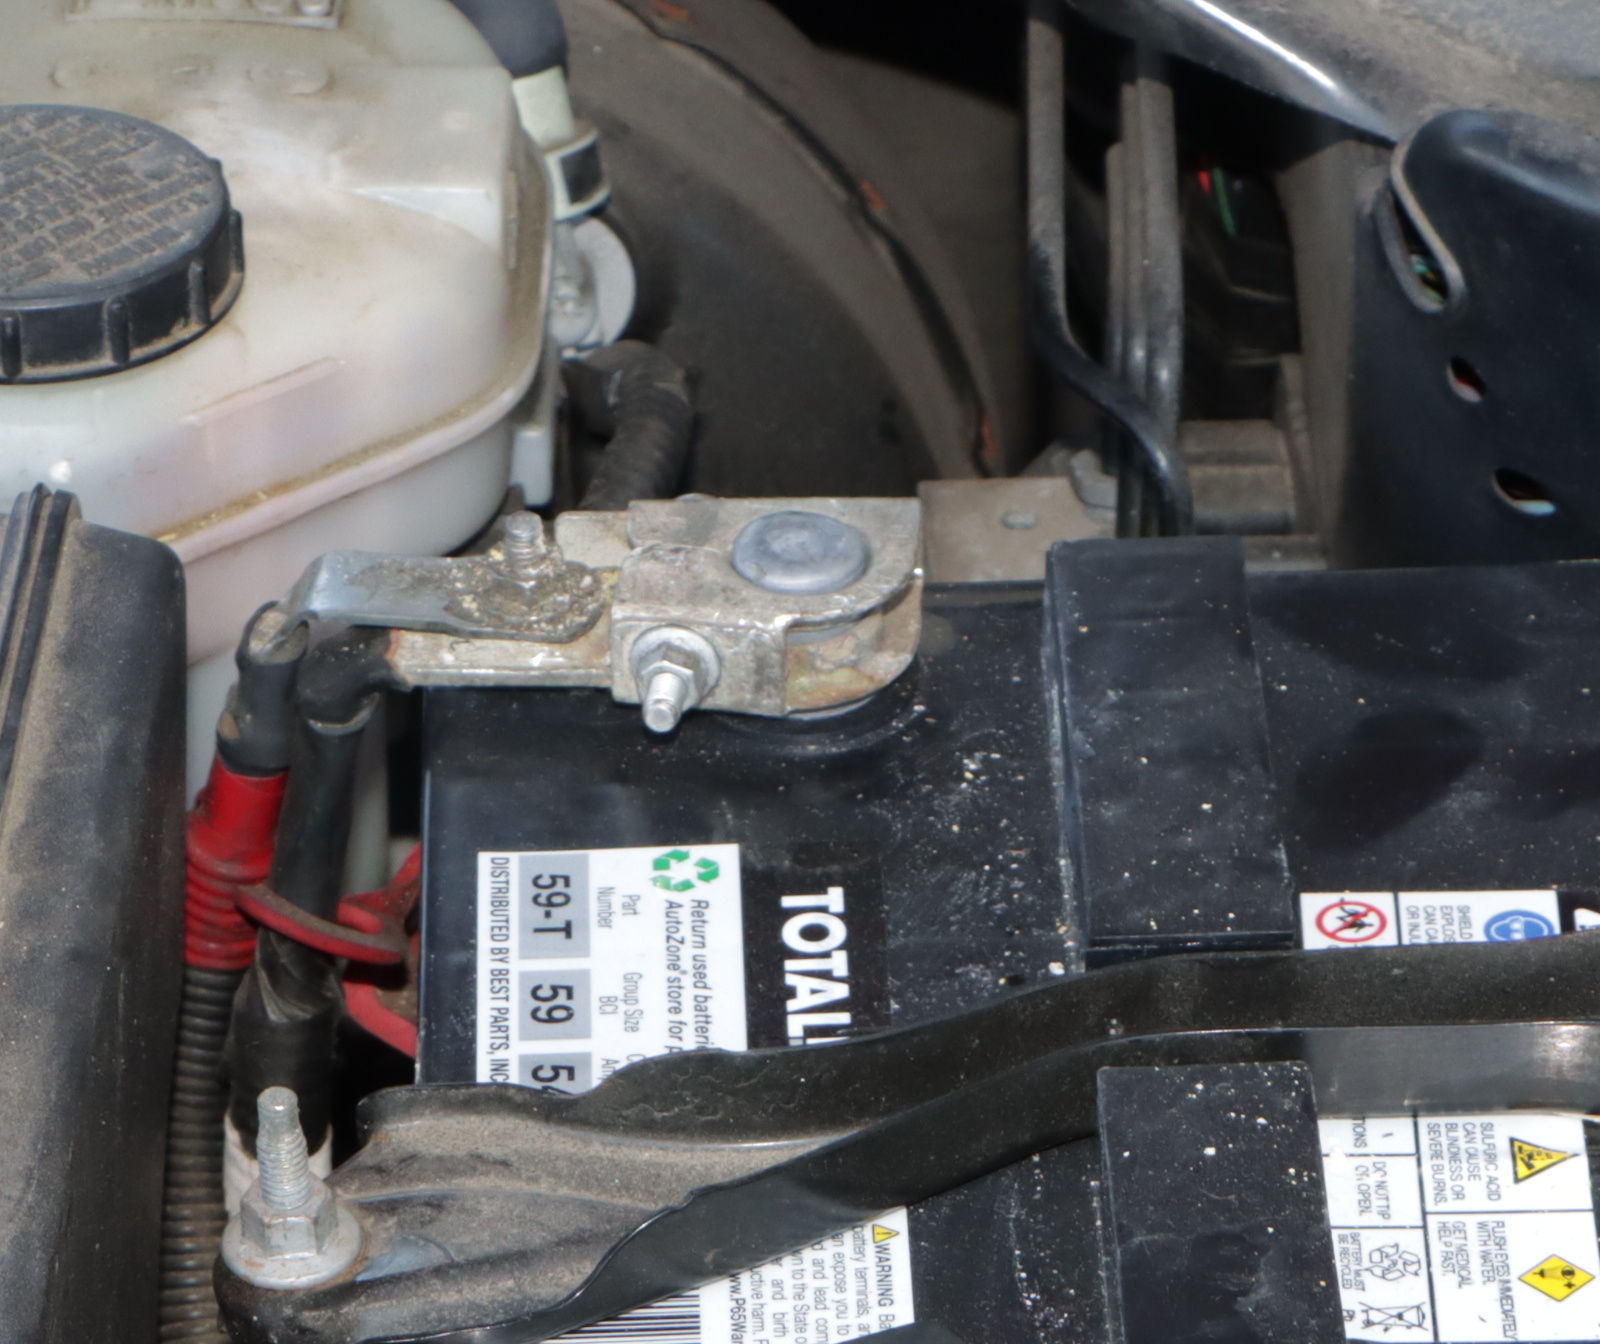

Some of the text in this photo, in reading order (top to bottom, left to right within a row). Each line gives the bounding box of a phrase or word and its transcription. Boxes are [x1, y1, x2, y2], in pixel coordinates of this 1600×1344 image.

[490, 856, 510, 943] DISTRIBUTED
[531, 873, 573, 940] 59-T
[597, 887, 616, 930] Number
[622, 894, 641, 917] Part
[1406, 905, 1420, 920] OR
[1423, 905, 1438, 925] CAN
[691, 898, 710, 949] Return
[1456, 905, 1473, 940] SHIELD
[490, 947, 510, 965] BY
[692, 955, 712, 991] used
[490, 968, 510, 1003] BEST
[620, 972, 643, 1006] Group
[667, 975, 685, 1016] store
[529, 984, 576, 1025] 59
[599, 995, 618, 1016] BCI
[624, 1009, 644, 1034] Size
[485, 1007, 510, 1056] PARTS,
[668, 1020, 688, 1042] for
[1427, 1122, 1448, 1206] SEVERE BURNS.
[1445, 1122, 1466, 1200] BLINDNESS OR
[1463, 1122, 1481, 1182] CAN CAUSE
[1480, 1122, 1501, 1202] SULFURIC ACID
[1357, 1184, 1373, 1216] OPEN.
[1374, 1181, 1390, 1203] NOT
[1376, 1203, 1391, 1220] TIP
[1350, 1232, 1363, 1266] BATTERY
[1437, 1221, 1456, 1276] HELP FAST.
[1491, 1220, 1507, 1250] FLUSH
[812, 1257, 829, 1280] and
[1337, 1233, 1353, 1290] BE RECYCLED
[1452, 1220, 1473, 1289] GET MEDICAL
[1476, 1220, 1496, 1285] WITH WATER.
[1495, 1251, 1510, 1278] EYES
[772, 1278, 789, 1301] and
[792, 1268, 807, 1280] to
[831, 1252, 847, 1294] expose
[875, 1242, 895, 1307] WARNING
[792, 1283, 809, 1301] the
[813, 1287, 831, 1311] lead
[831, 1298, 849, 1320] you
[855, 1266, 874, 1318] terminals,
[752, 1303, 768, 1335] harm.
[773, 1311, 789, 1338] birth
[793, 1304, 811, 1334] State
[837, 1324, 852, 1336] to
